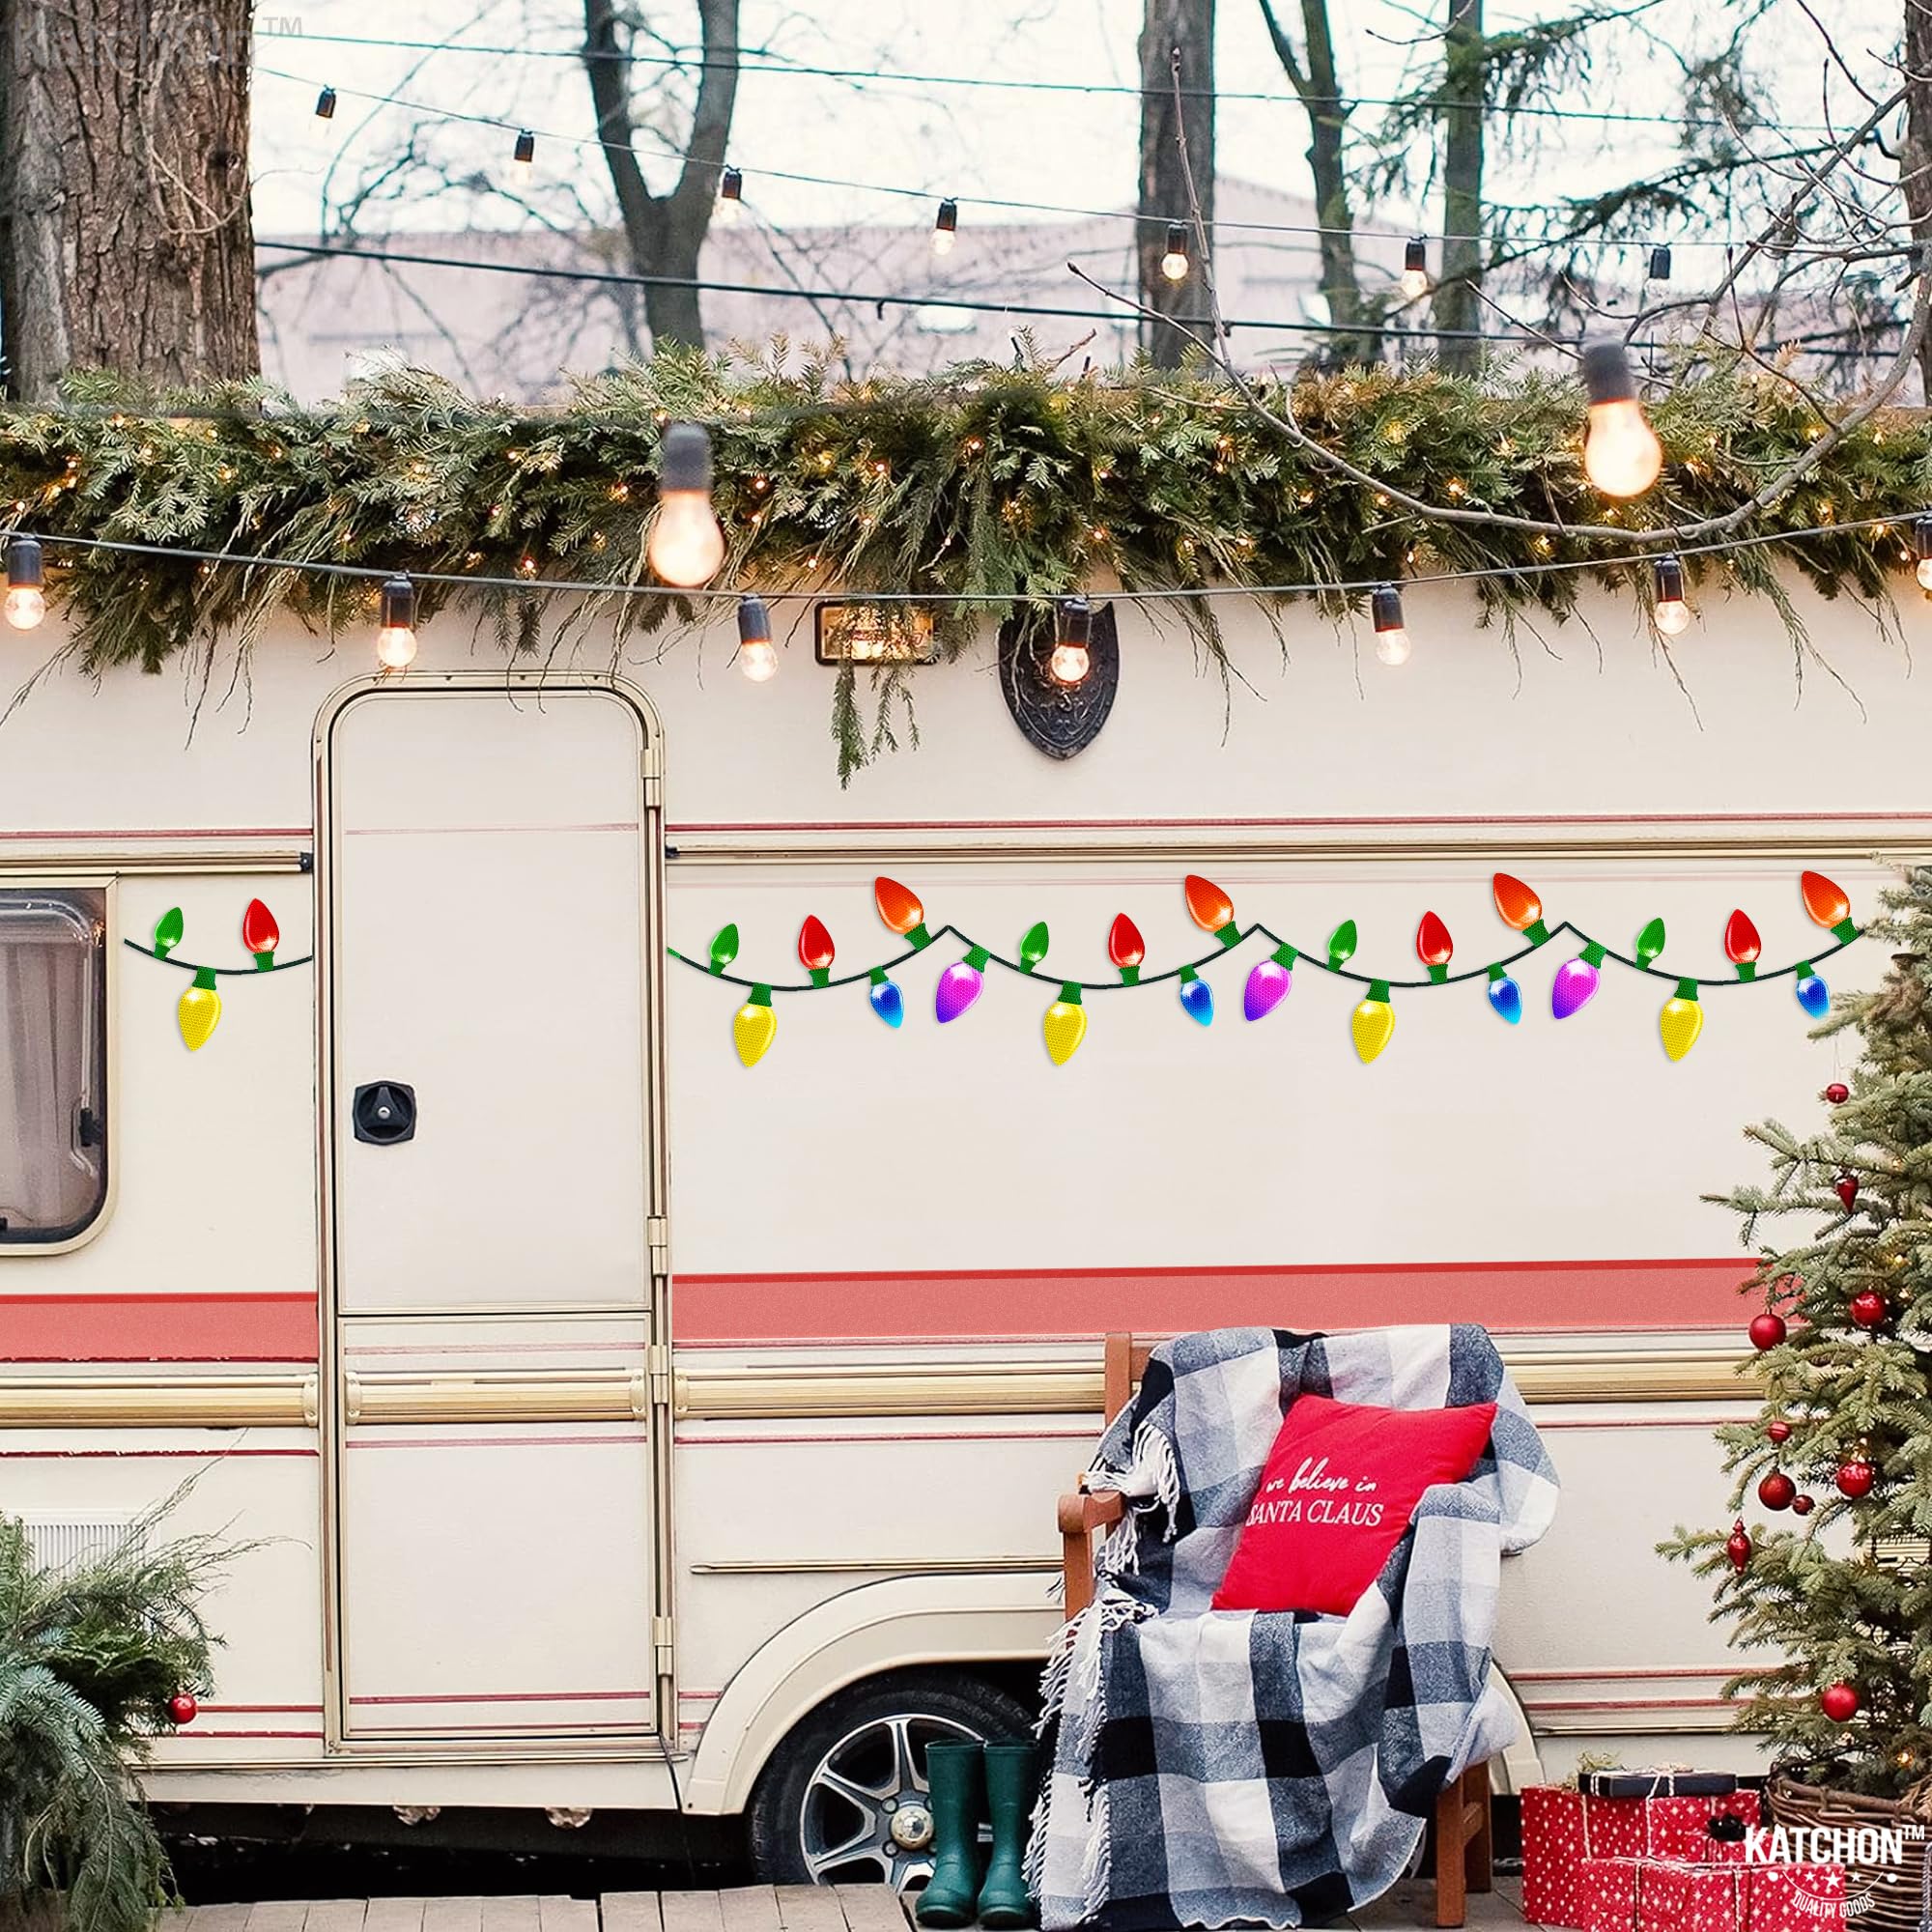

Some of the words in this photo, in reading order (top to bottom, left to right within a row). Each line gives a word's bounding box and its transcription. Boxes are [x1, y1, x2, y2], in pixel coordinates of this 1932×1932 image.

[1266, 1477, 1285, 1493] we
[1288, 1457, 1350, 1493] believe
[1355, 1476, 1378, 1492] in
[1307, 1499, 1384, 1526] CLAUS
